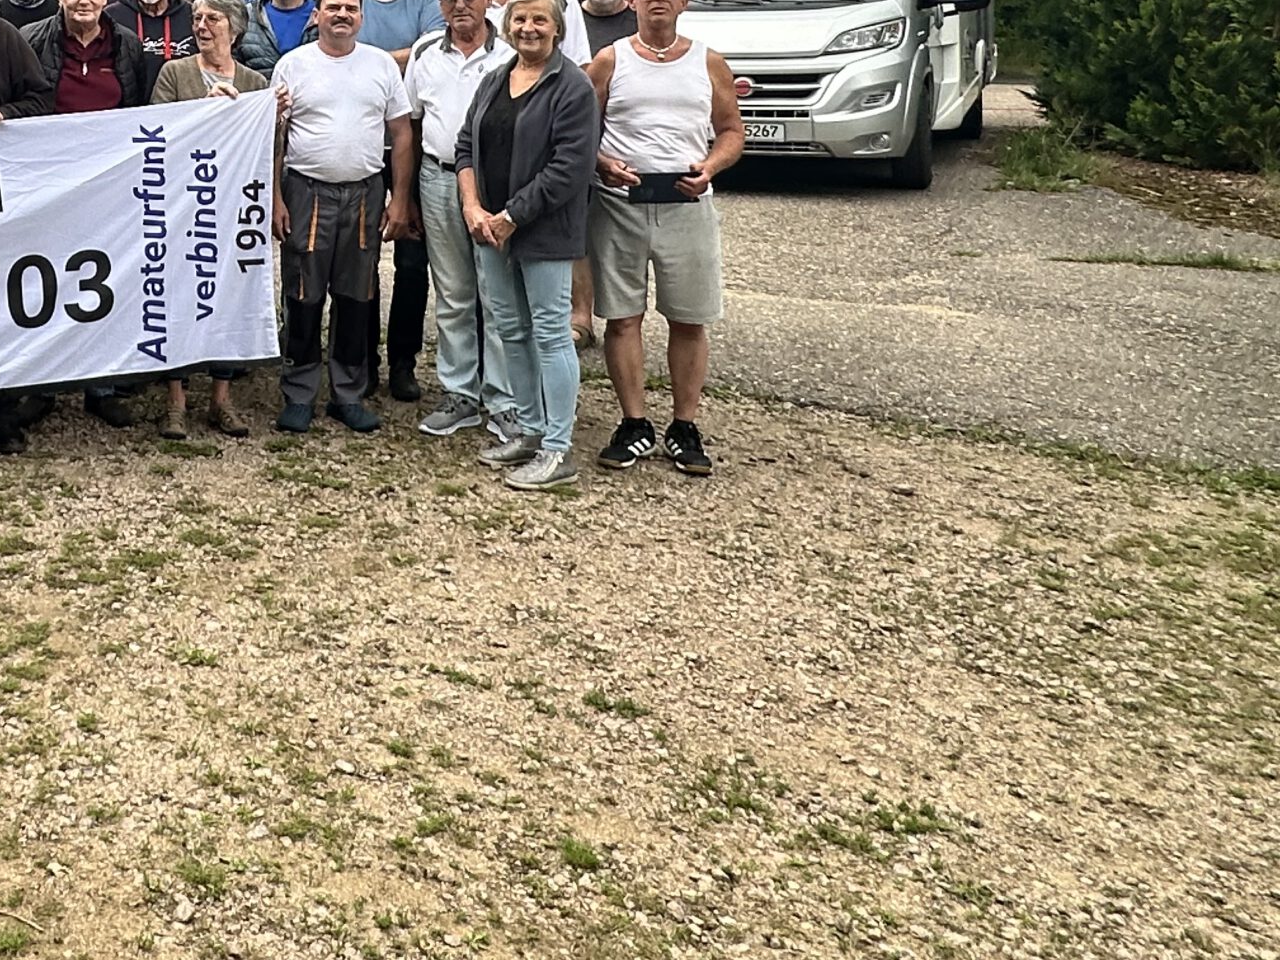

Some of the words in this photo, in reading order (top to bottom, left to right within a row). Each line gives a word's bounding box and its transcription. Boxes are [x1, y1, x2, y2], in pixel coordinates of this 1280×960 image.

[744, 124, 778, 138] 5267
[132, 125, 167, 363] Amateurfunk
[186, 149, 217, 321] verbindet
[238, 179, 266, 273] 1954
